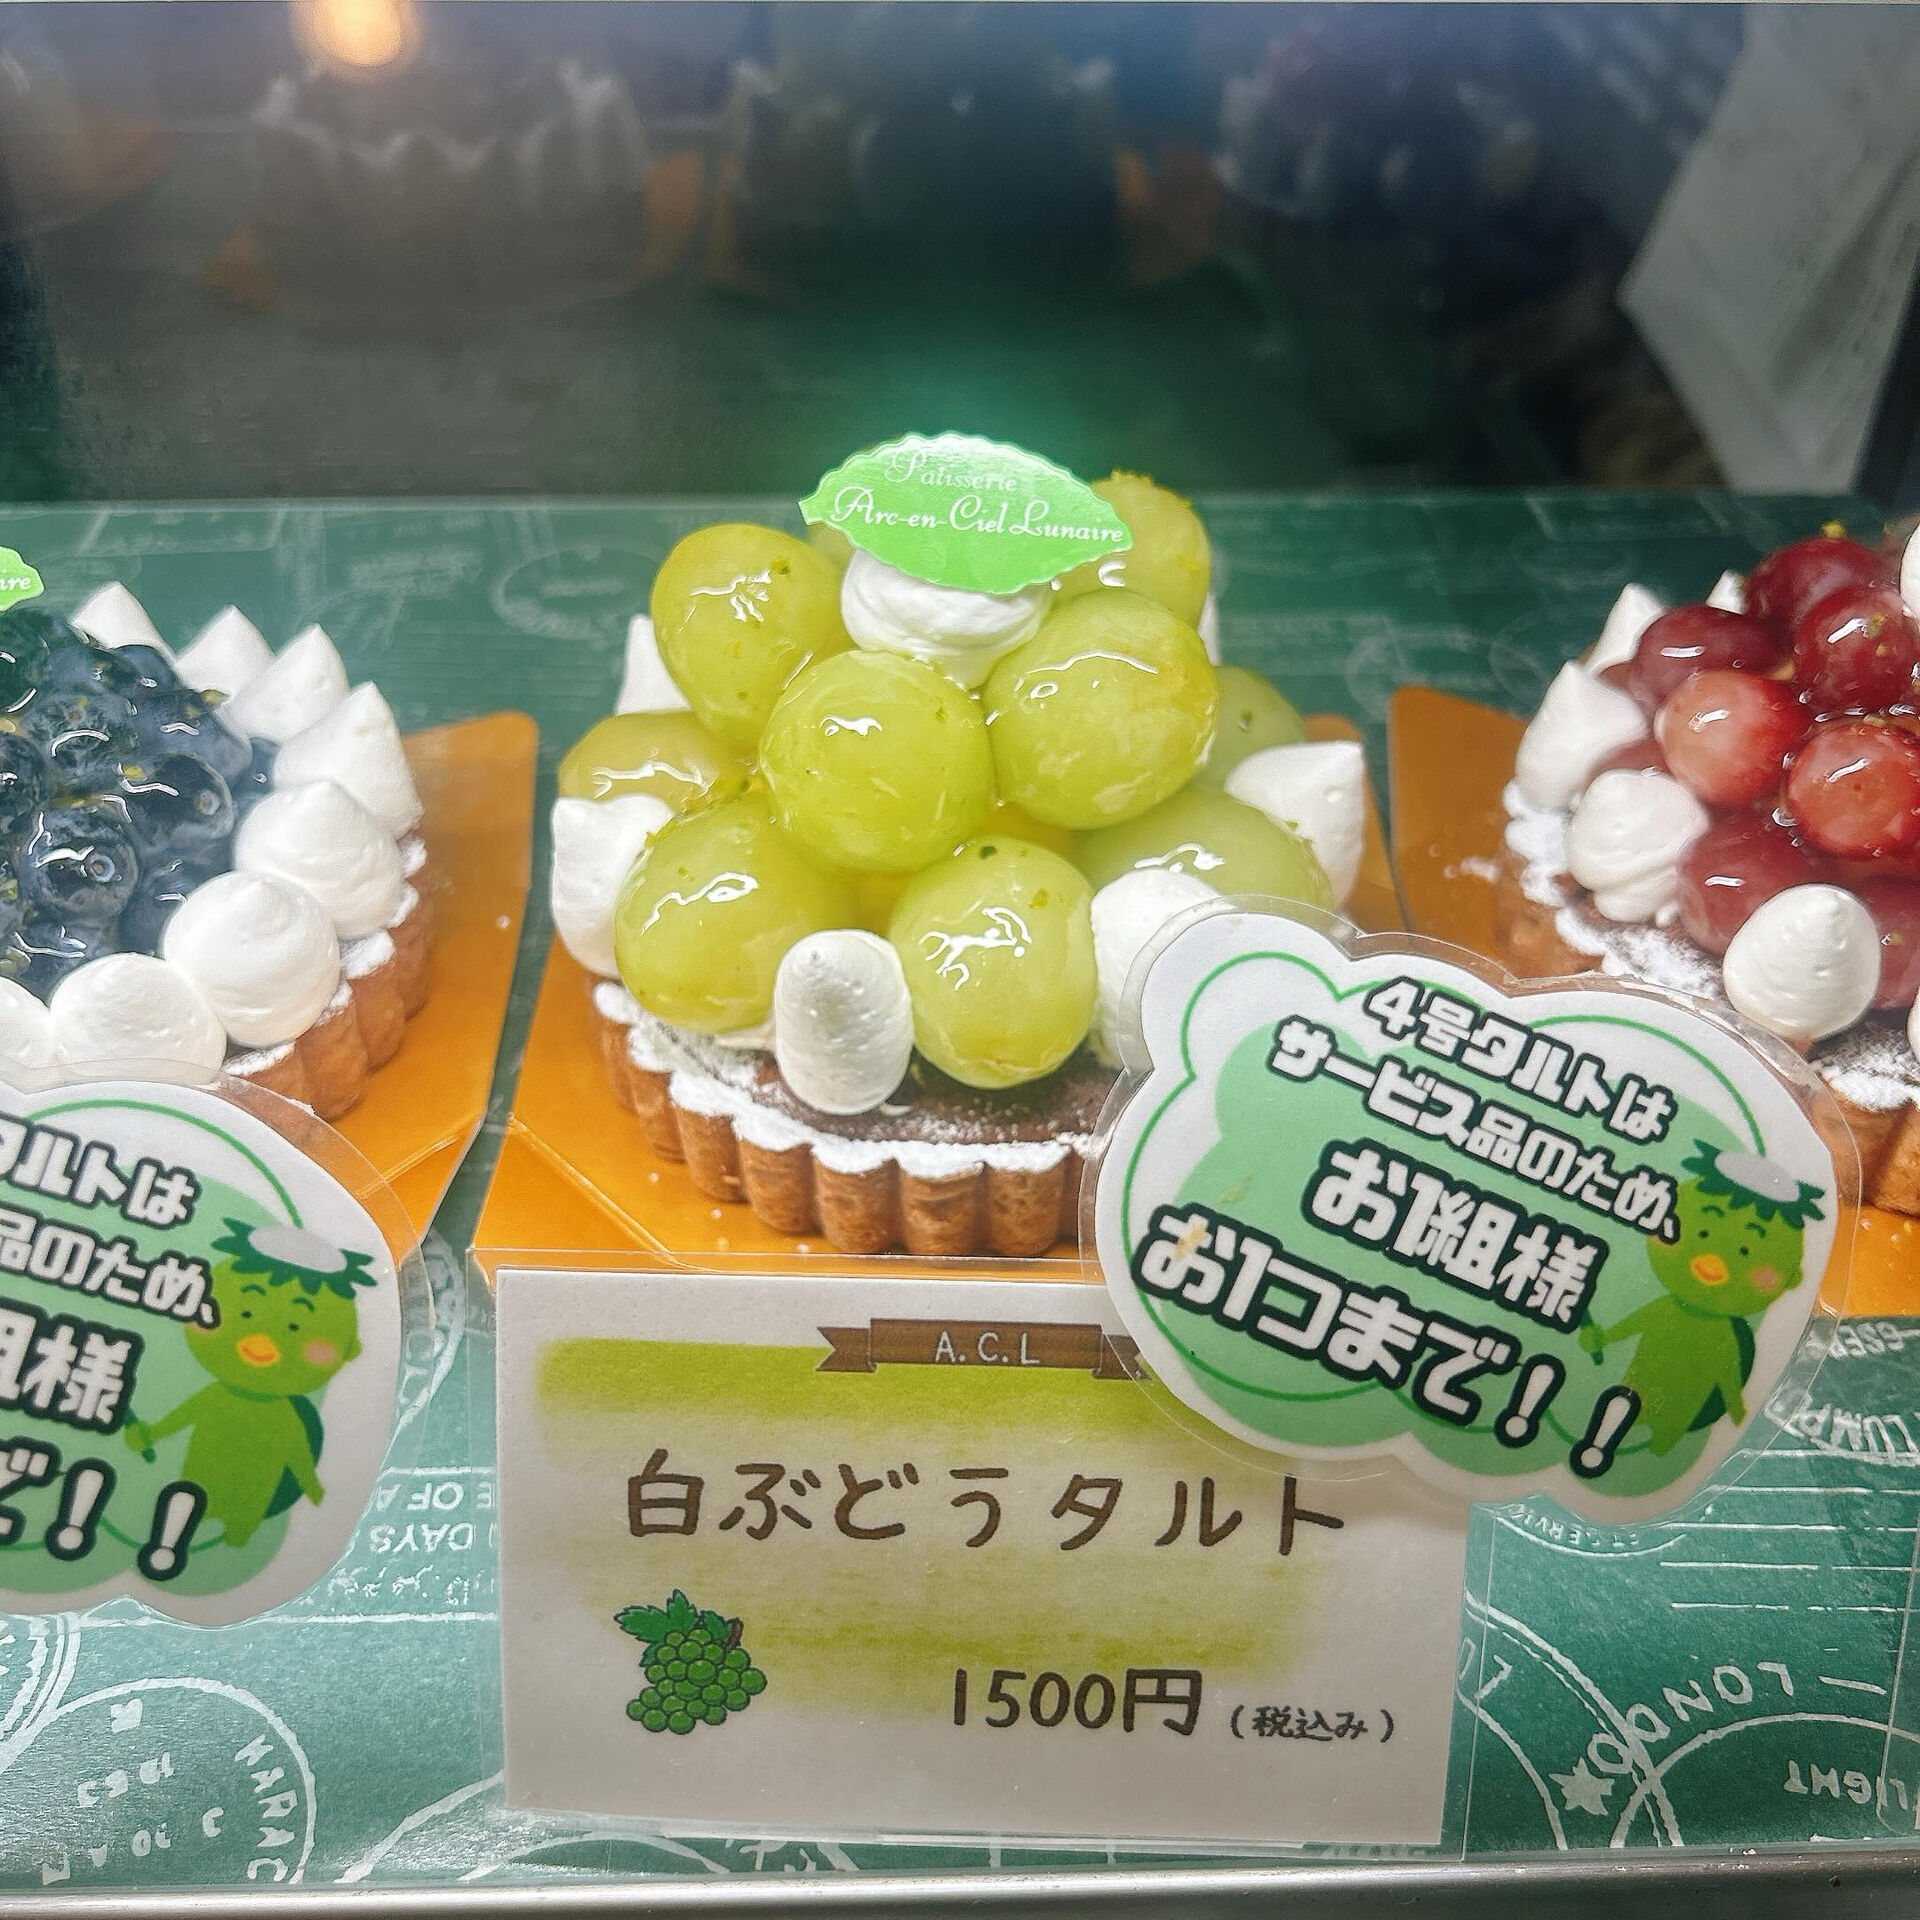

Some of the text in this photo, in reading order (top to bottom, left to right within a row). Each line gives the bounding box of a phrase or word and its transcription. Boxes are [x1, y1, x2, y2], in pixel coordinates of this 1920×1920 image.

[1009, 500, 1124, 543] Lunaire
[1368, 980, 1673, 1141] 4号タルトは
[1310, 1146, 1601, 1324] お1組様
[627, 1447, 1345, 1556] 白ぶどうタルト
[953, 1667, 1204, 1736] 1500円
